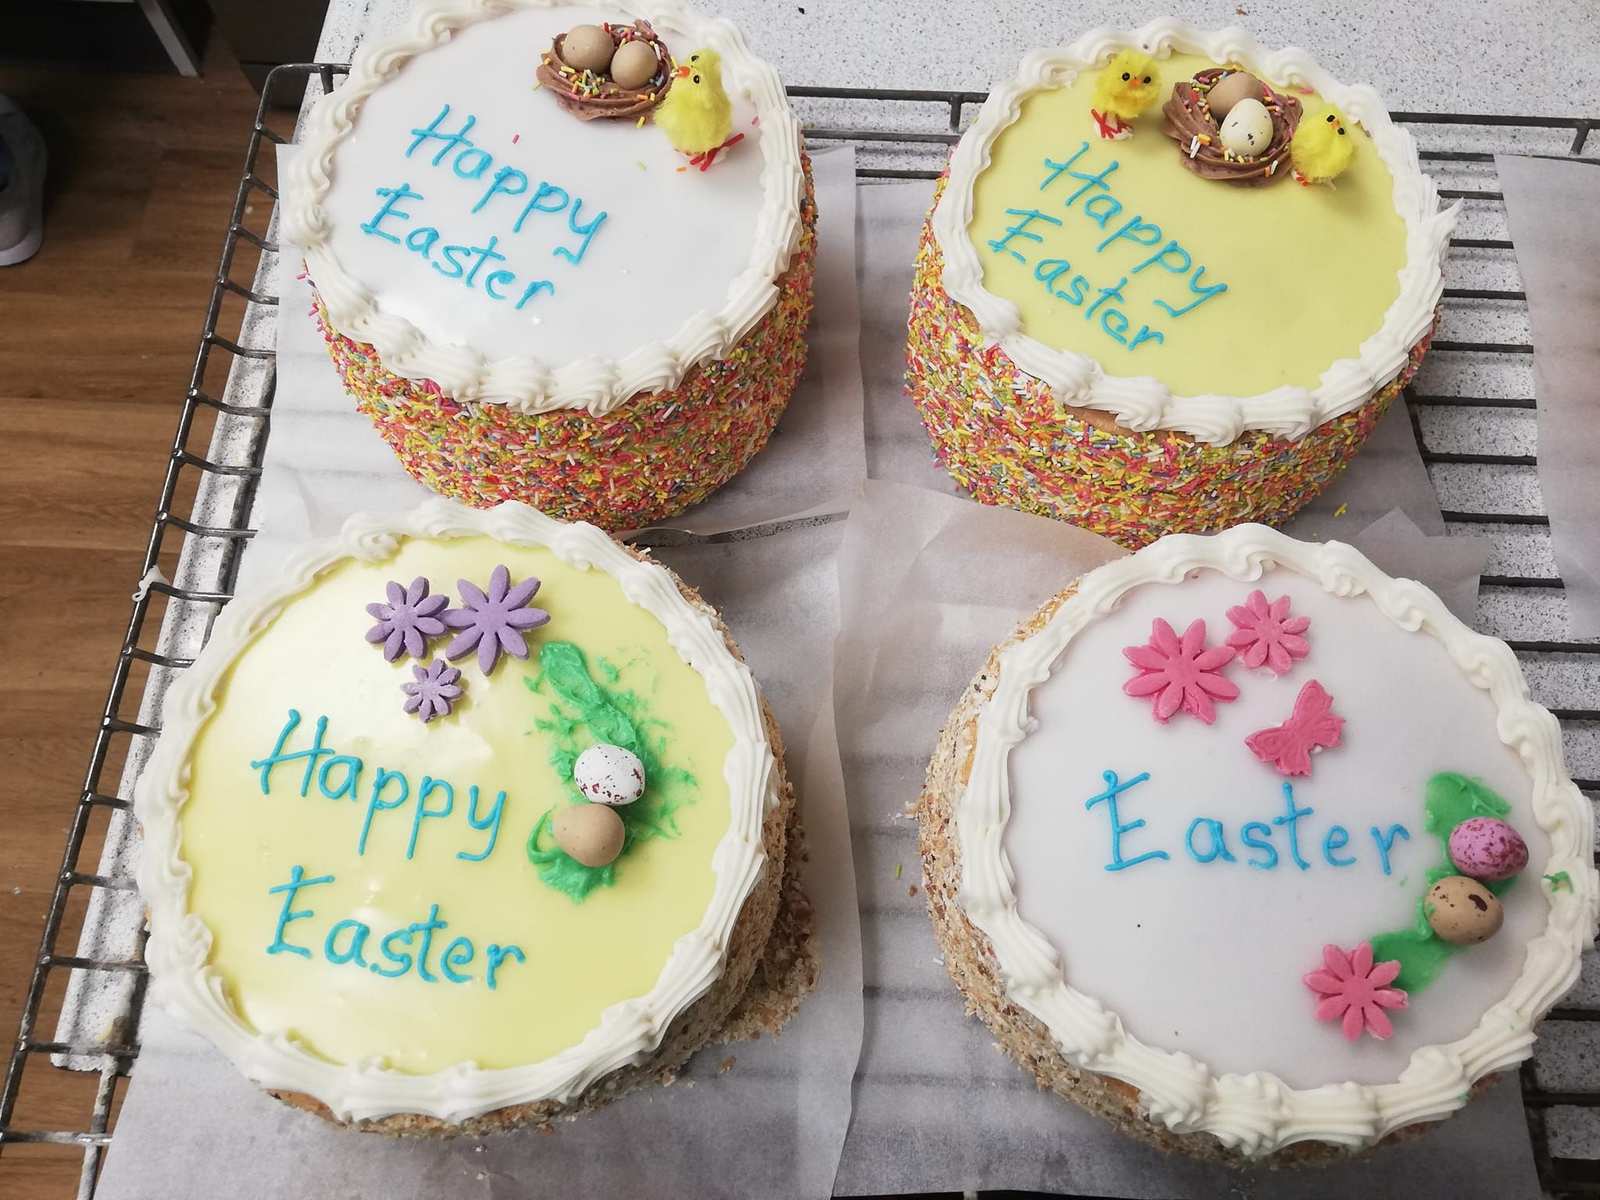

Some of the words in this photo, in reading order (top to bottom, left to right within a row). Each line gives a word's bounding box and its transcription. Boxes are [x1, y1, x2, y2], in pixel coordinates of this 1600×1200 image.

[361, 183, 556, 310] Easter
[406, 104, 608, 265] Happy
[1040, 141, 1228, 317] Happy
[988, 208, 1165, 351] Easter
[250, 709, 507, 862] Happy
[1085, 769, 1410, 875] Easter
[266, 865, 526, 990] Easter
